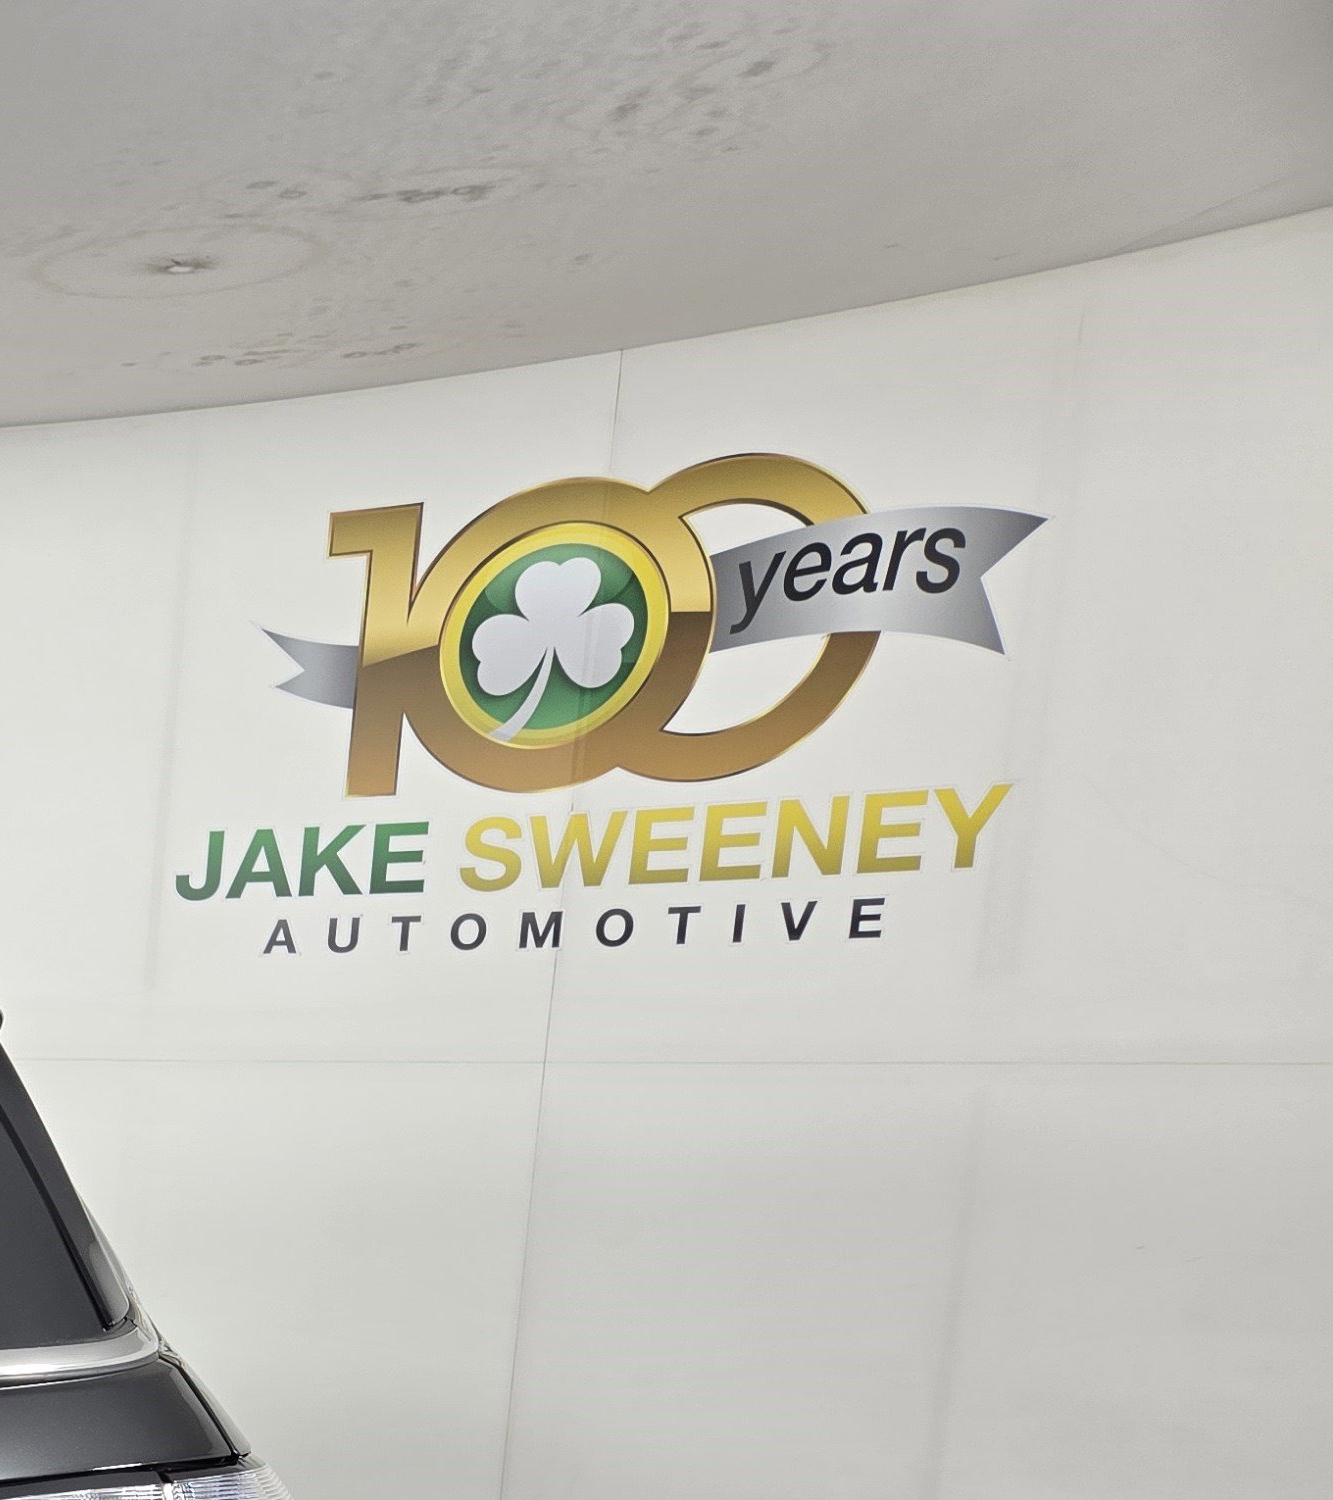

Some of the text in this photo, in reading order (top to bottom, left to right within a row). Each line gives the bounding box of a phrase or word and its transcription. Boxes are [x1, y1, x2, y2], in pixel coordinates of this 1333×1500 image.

[729, 522, 966, 636] years
[174, 782, 1015, 904] JAKE SWEENEY
[262, 896, 889, 956] AUTOMOTIVE
